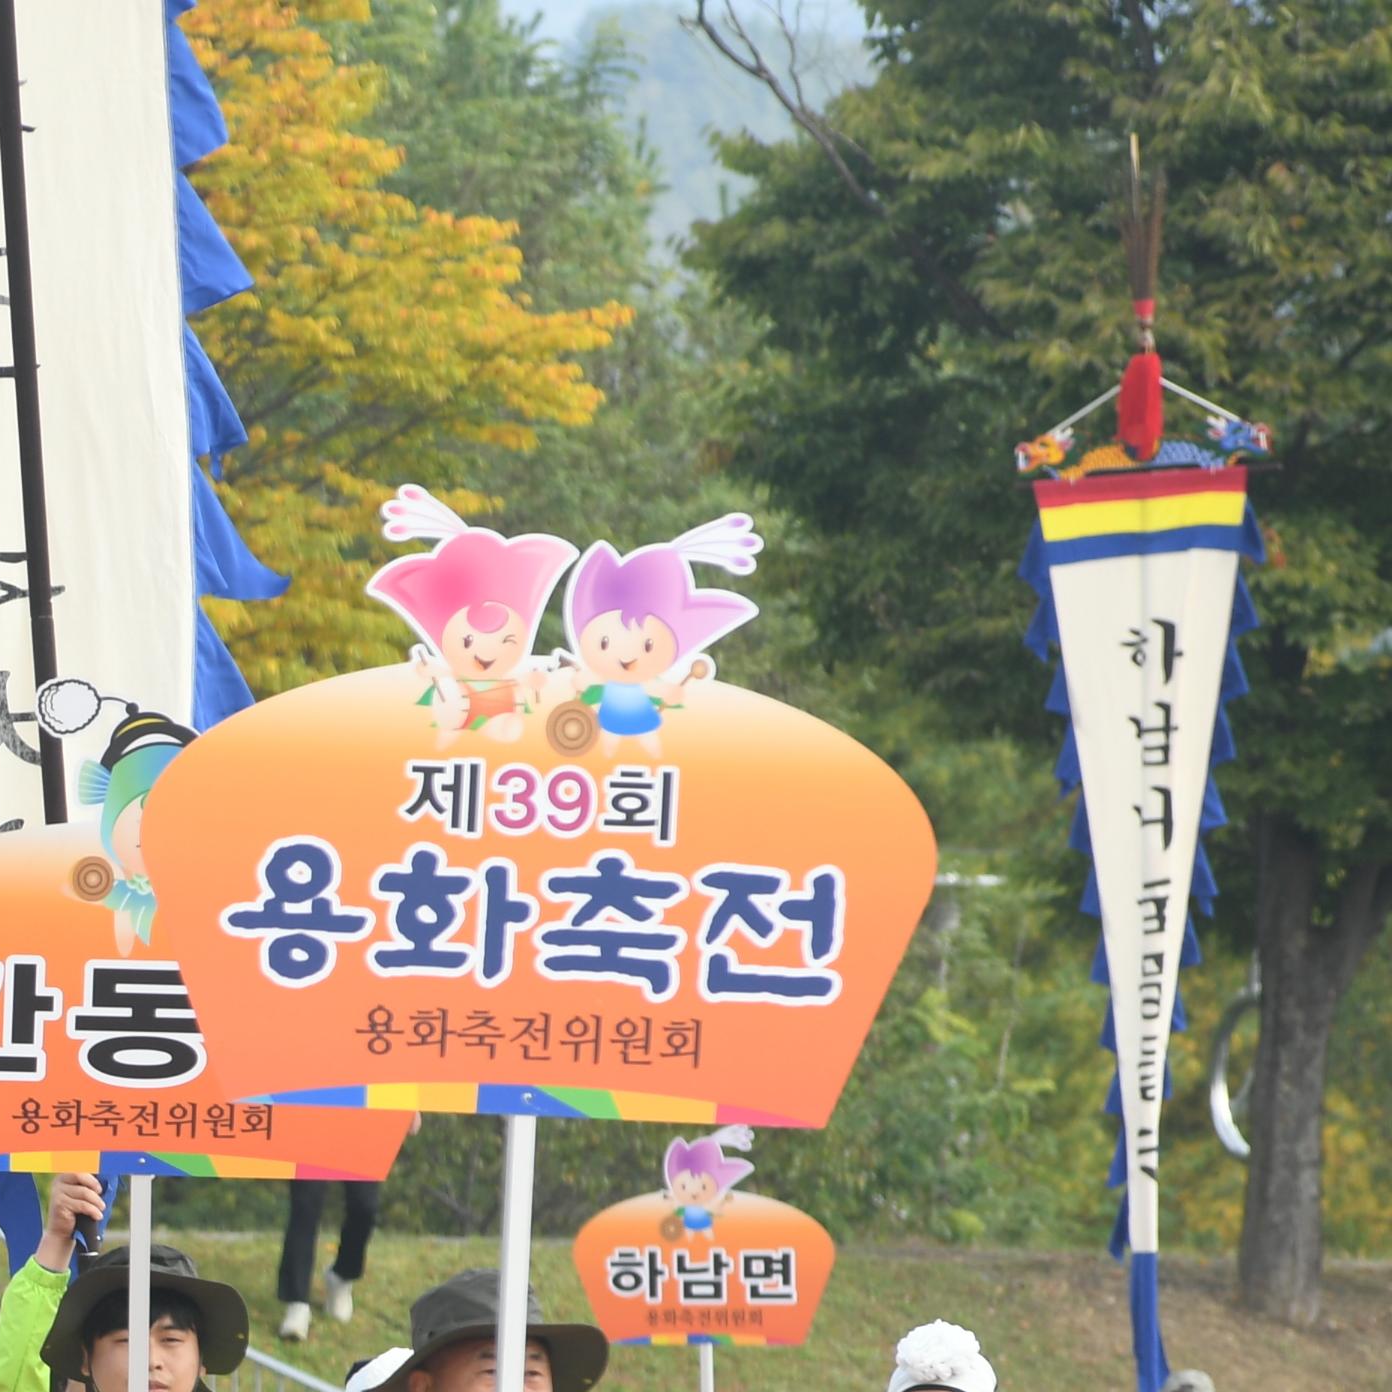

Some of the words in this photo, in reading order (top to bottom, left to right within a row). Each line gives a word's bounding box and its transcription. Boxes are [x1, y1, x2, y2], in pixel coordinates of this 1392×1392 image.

[404, 760, 674, 842] 제39회
[225, 840, 840, 1000] 용화축전
[353, 1003, 703, 1069] 용화축전위원회
[12, 1096, 274, 1141] 용화축전위원회
[608, 1249, 794, 1301] 하남면
